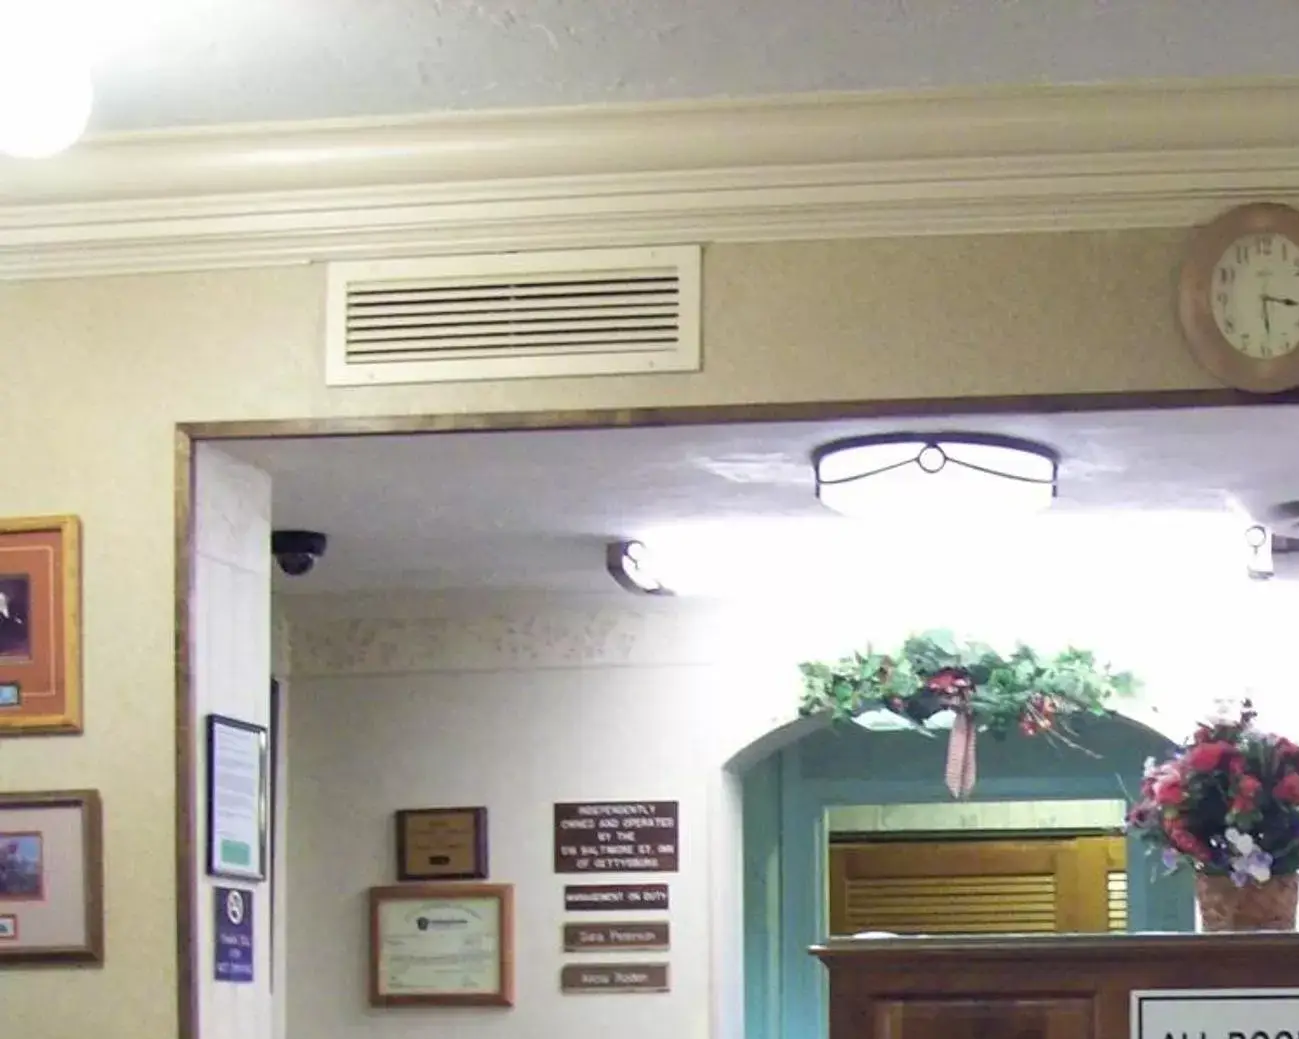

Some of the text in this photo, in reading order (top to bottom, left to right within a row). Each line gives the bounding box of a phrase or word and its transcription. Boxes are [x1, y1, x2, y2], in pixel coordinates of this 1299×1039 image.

[598, 817, 620, 829] AND
[597, 830, 637, 842] BY THE
